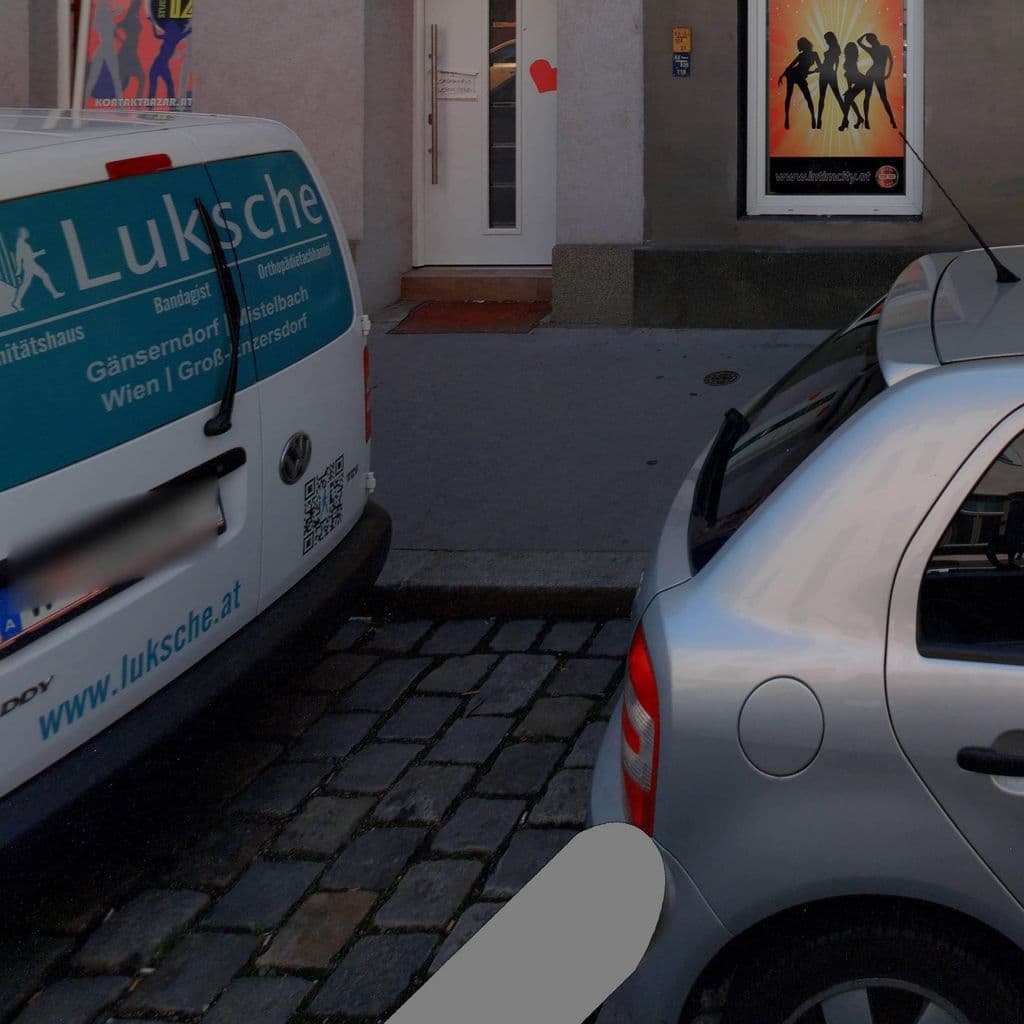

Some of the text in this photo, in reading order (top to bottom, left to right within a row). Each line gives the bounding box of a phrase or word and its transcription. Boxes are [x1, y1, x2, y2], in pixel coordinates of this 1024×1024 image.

[60, 174, 323, 291] Luksche
[153, 281, 212, 315] Bandagist
[86, 317, 220, 384] Gänserndorf
[101, 311, 308, 413] Wien Groß-nzersdorf
[39, 580, 242, 741] www.luksche.at
